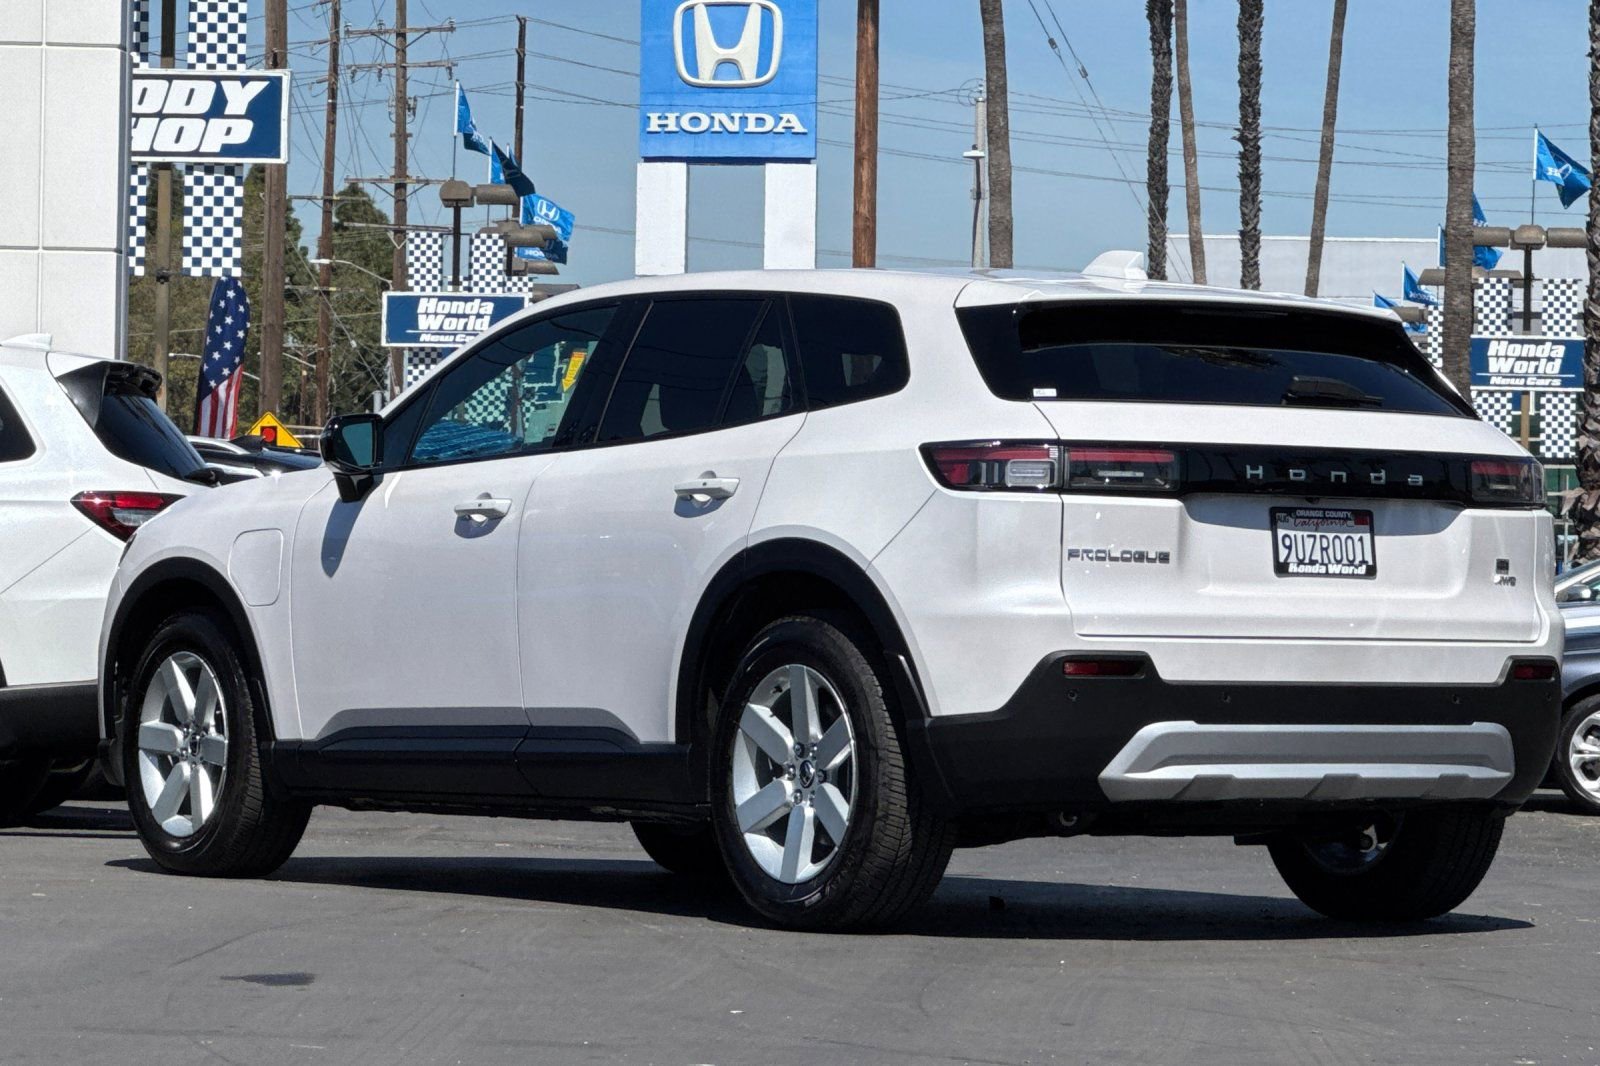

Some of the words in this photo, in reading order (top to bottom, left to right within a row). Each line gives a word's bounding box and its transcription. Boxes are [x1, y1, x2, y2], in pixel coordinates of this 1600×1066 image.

[646, 112, 808, 134] HONDA
[417, 297, 495, 315] Honda
[417, 313, 491, 331] World
[419, 333, 454, 342] New
[1487, 340, 1566, 358] Honda
[1488, 357, 1562, 374] World
[1489, 376, 1525, 385] New
[1526, 377, 1562, 386] Cars
[1295, 509, 1324, 518] ORANGE
[1325, 511, 1352, 519] COUNTY
[1067, 548, 1170, 564] PROLOGUE
[1281, 533, 1369, 564] 9UZR001
[1288, 562, 1327, 574] Honda
